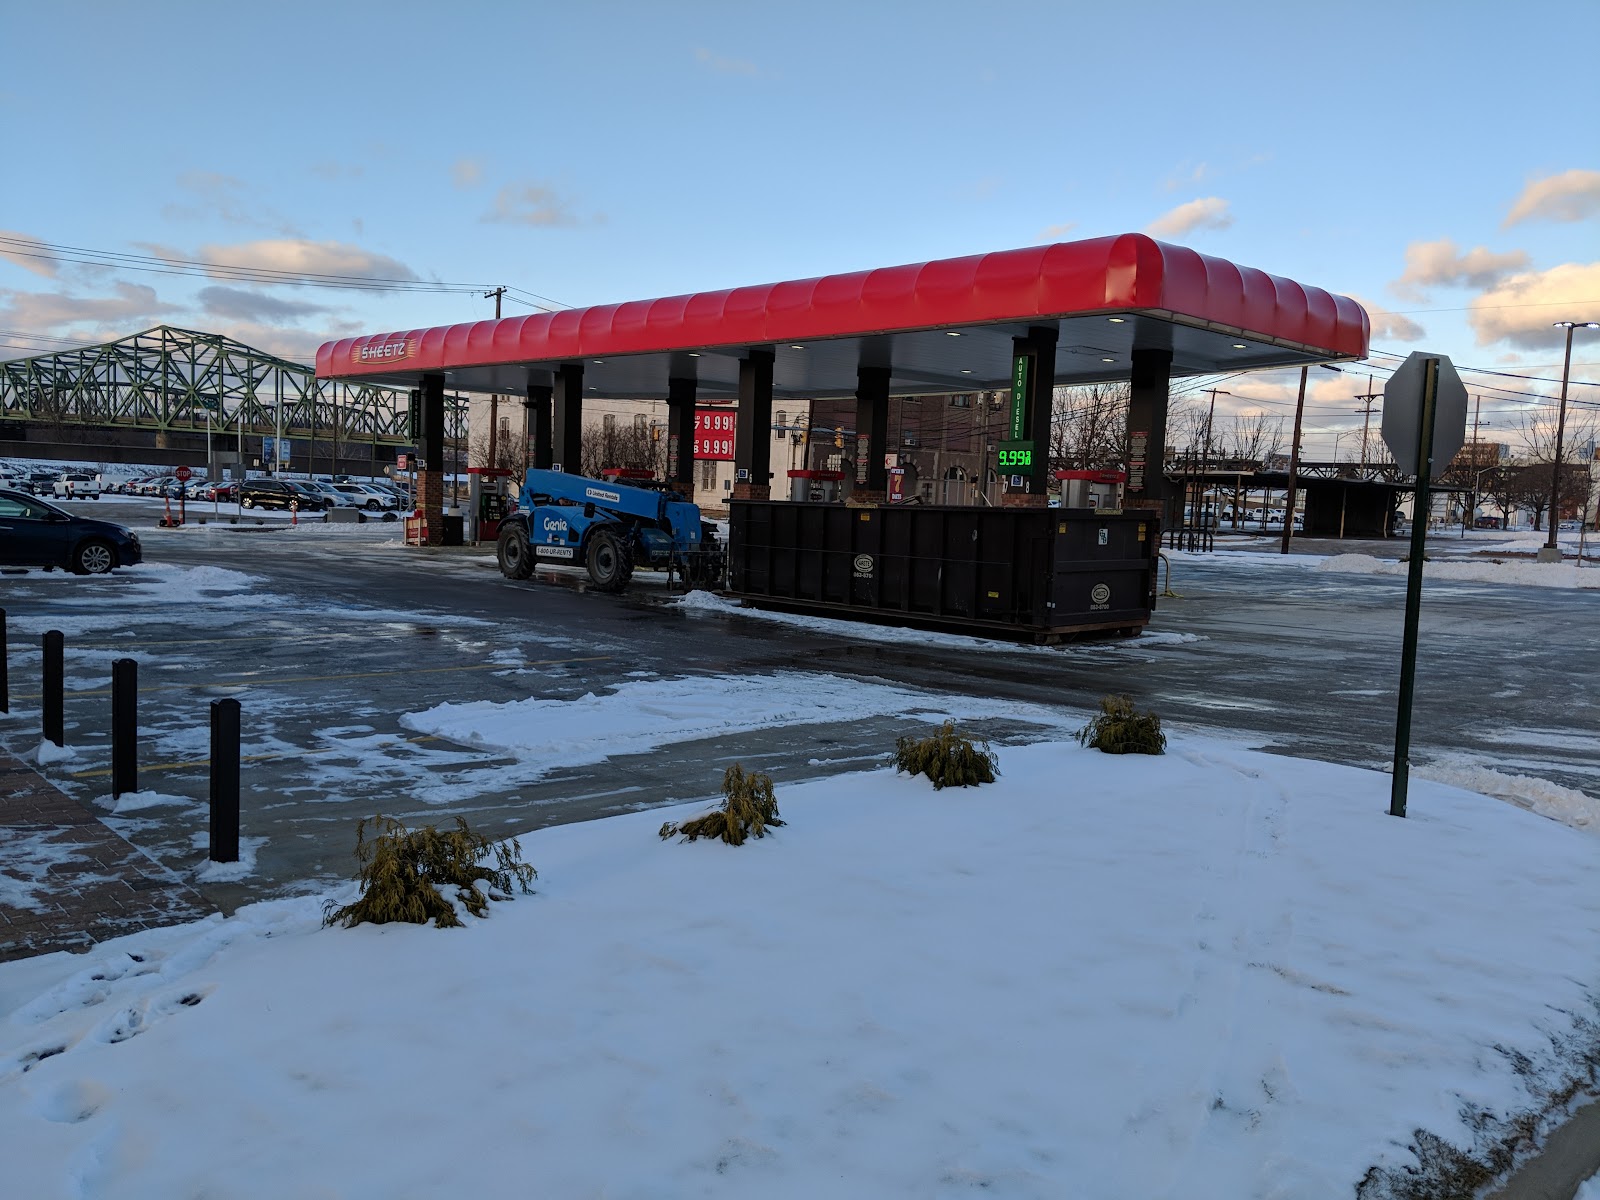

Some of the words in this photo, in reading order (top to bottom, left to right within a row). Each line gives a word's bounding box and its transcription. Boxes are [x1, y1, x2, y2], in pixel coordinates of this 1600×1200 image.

[361, 342, 405, 359] SHEETZ
[1014, 392, 1022, 439] DIESEL
[176, 470, 191, 478] STOP
[894, 474, 902, 493] 7
[543, 517, 567, 531] Genie
[537, 547, 572, 557] 1-800-UR-RENTS
